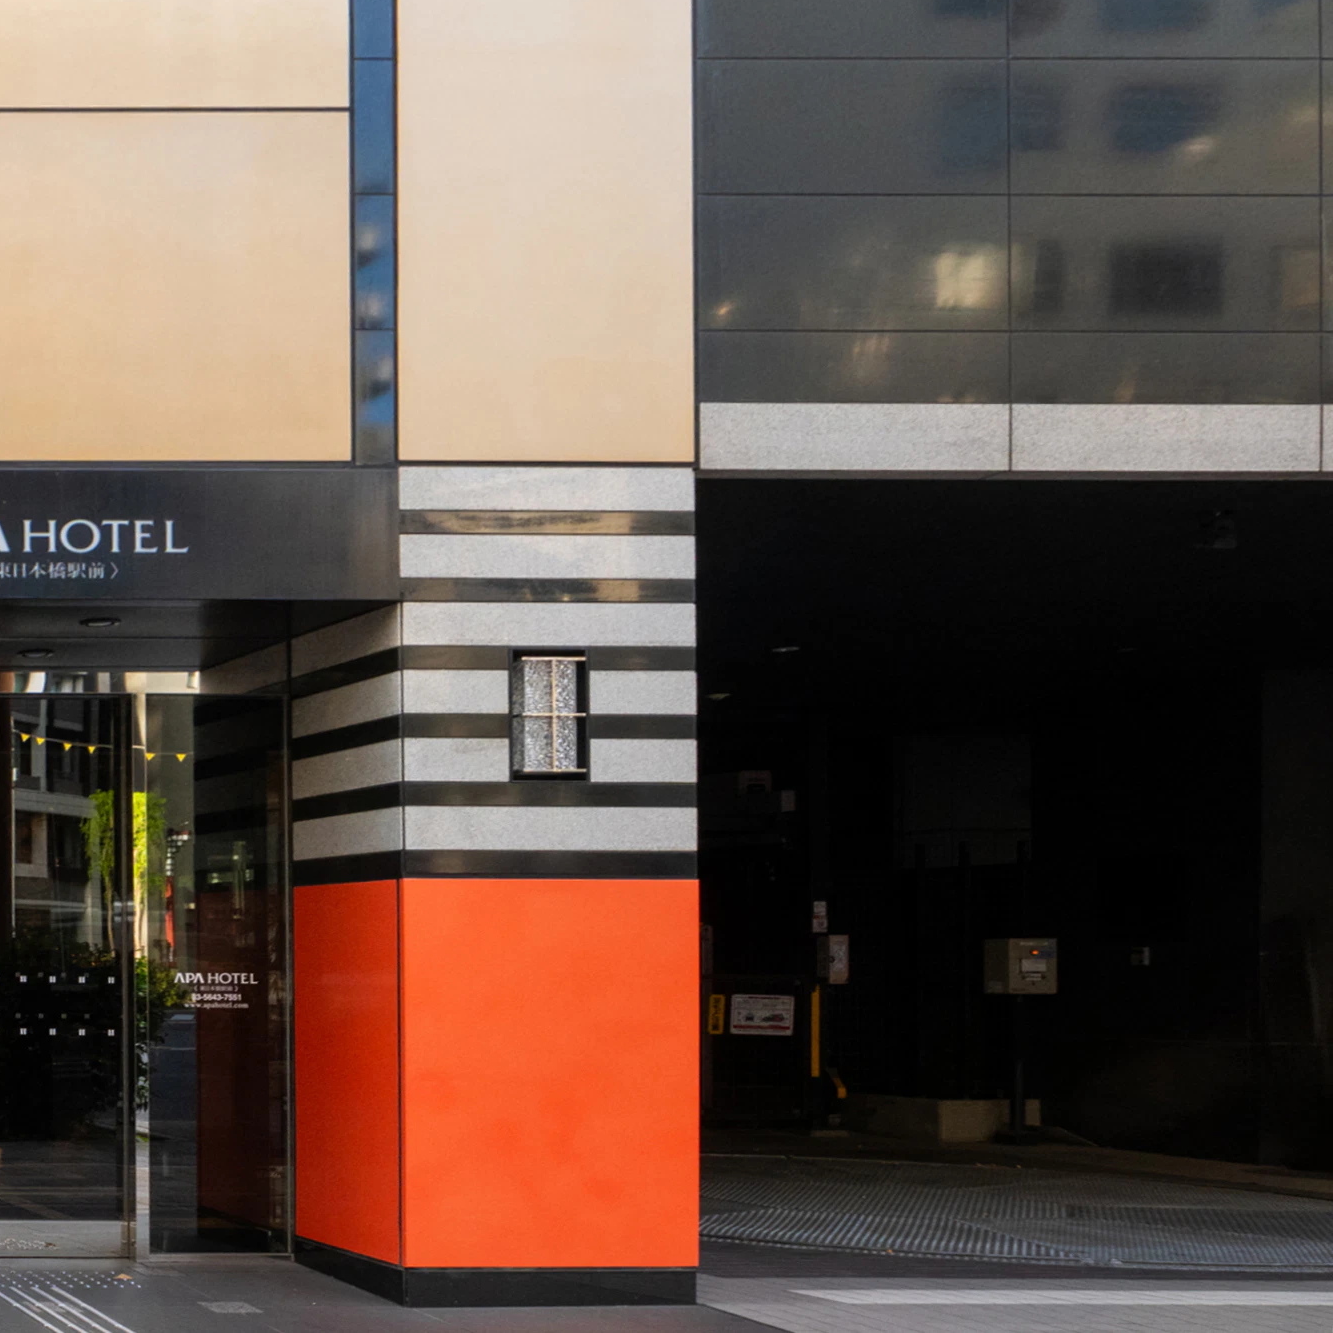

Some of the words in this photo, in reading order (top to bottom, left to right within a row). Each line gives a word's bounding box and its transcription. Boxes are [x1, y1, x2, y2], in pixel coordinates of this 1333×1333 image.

[22, 518, 190, 554] HOTEL
[173, 972, 205, 984] APA
[207, 972, 259, 985] HOTEL
